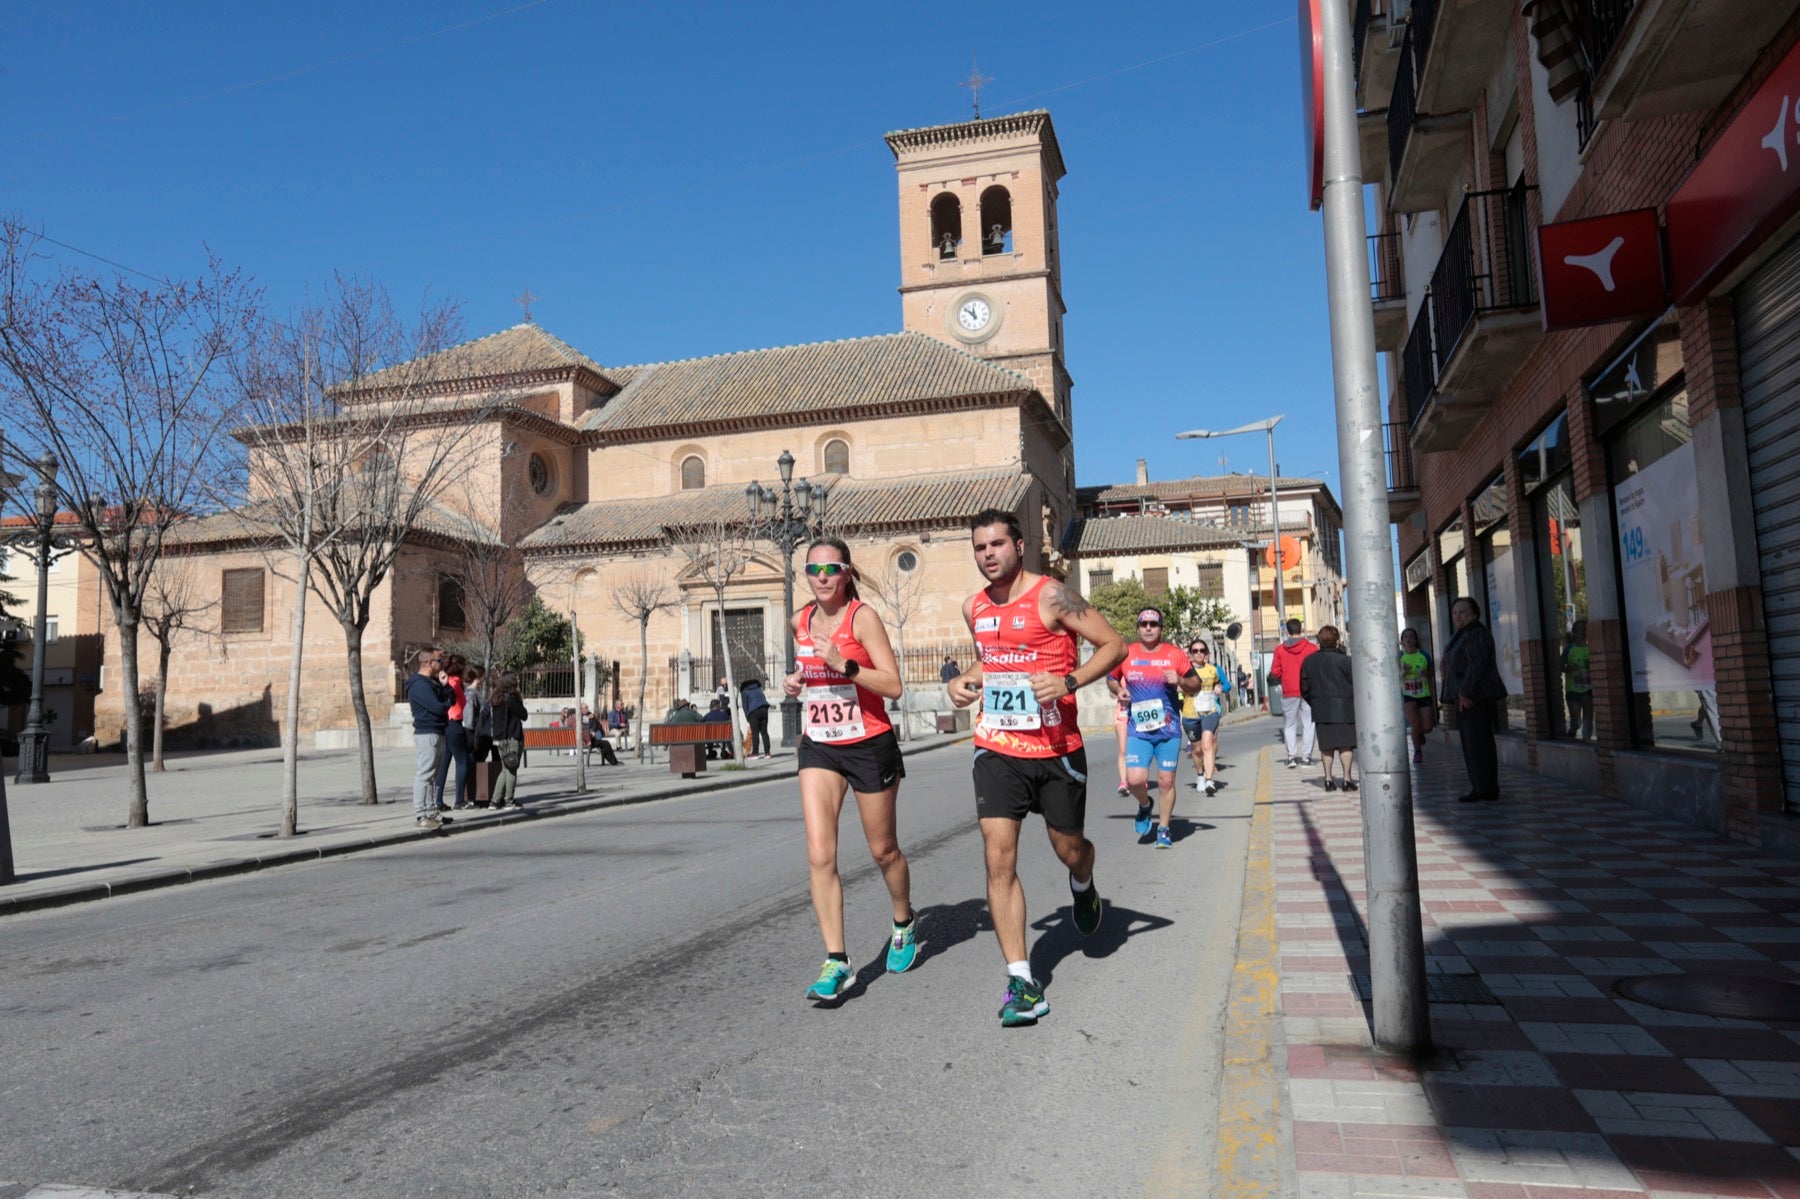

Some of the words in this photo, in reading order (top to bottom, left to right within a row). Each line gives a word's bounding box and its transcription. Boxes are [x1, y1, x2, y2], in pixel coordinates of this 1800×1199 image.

[1623, 526, 1643, 562] 149
[810, 700, 856, 723] 2137
[991, 690, 1026, 711] 721
[1137, 709, 1159, 723] 596
